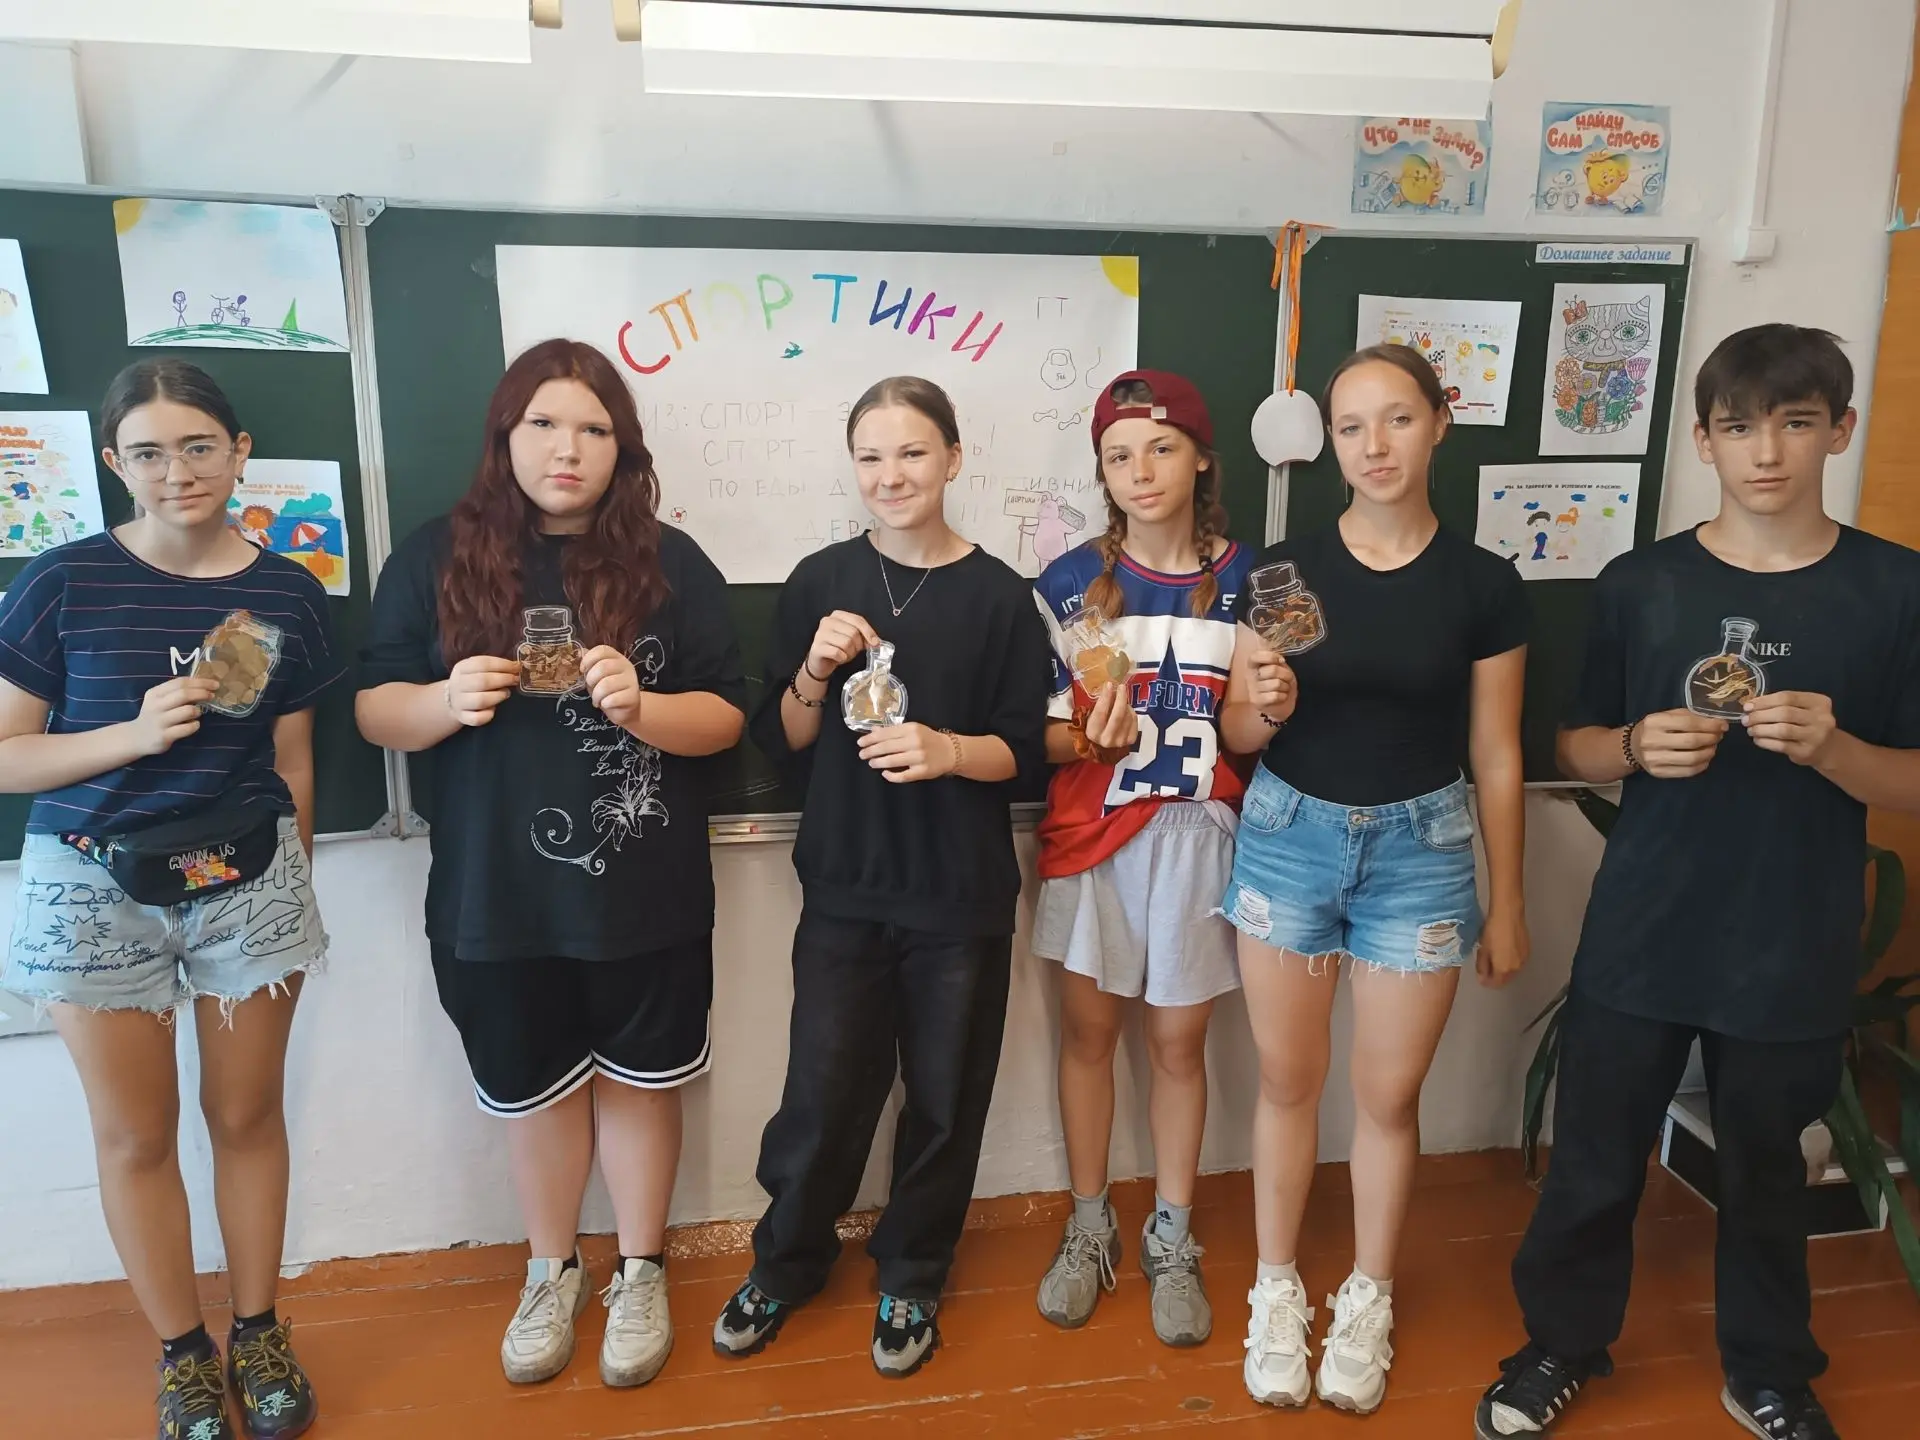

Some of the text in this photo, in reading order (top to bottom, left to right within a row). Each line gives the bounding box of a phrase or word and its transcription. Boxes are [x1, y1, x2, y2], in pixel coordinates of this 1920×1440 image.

[1575, 110, 1624, 130] НАЙДУ
[1364, 126, 1398, 147] ЧТО
[1547, 127, 1583, 148] САМ
[1607, 130, 1660, 149] СПОСОБ
[1540, 245, 1672, 261] Домашнее задание
[617, 273, 1004, 375] СПОРТИКИ
[699, 401, 799, 430] СПОРТ
[1748, 642, 1792, 657] NIKE
[574, 717, 614, 732] Live
[577, 736, 626, 762] Laugh
[591, 762, 626, 776] Love
[1103, 714, 1218, 806] 23
